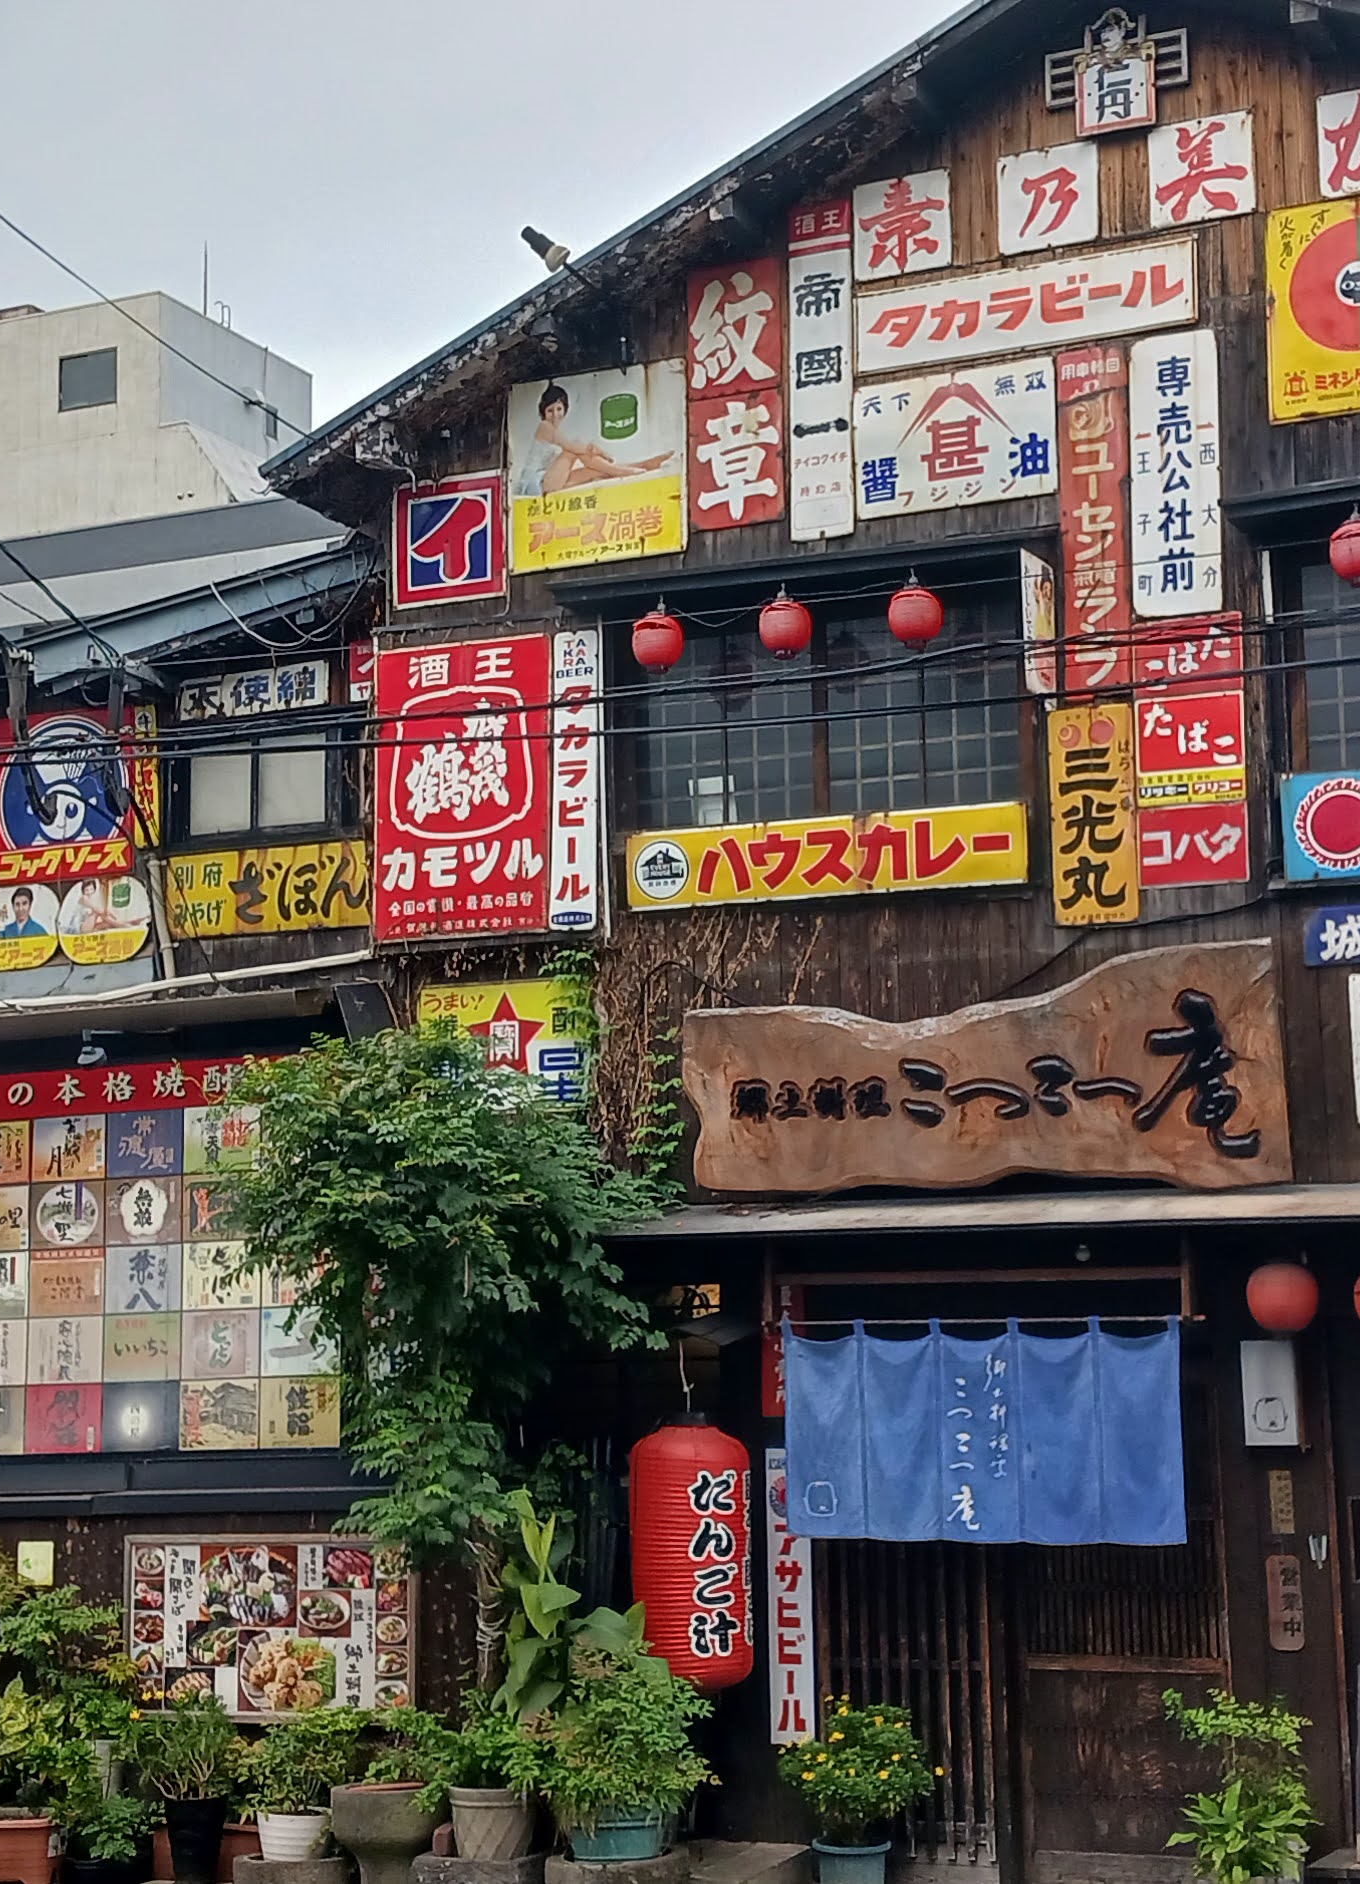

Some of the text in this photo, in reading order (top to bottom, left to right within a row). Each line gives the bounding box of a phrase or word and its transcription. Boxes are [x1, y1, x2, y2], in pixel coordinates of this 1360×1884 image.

[1095, 61, 1134, 123] 仁丹
[866, 262, 1184, 349] タカラビール
[1008, 432, 1050, 478] 油
[1155, 355, 1195, 594] 専売公社前
[528, 506, 664, 554] アース渦巻
[1137, 452, 1153, 597] 王子町
[1199, 443, 1218, 588] 西大分
[408, 647, 514, 689] 酒王
[1143, 703, 1238, 765] たばこ
[557, 685, 592, 902] タカラビール
[1059, 747, 1127, 910] 三光丸
[228, 855, 366, 925] ざぼん
[381, 838, 544, 891] カモツル
[697, 818, 1012, 895] ハウスカレー
[124, 1249, 162, 1310] 兼八
[114, 1337, 168, 1357] いいちこ
[688, 1471, 741, 1658] だんご汁
[775, 1522, 807, 1734] アサヒビール
